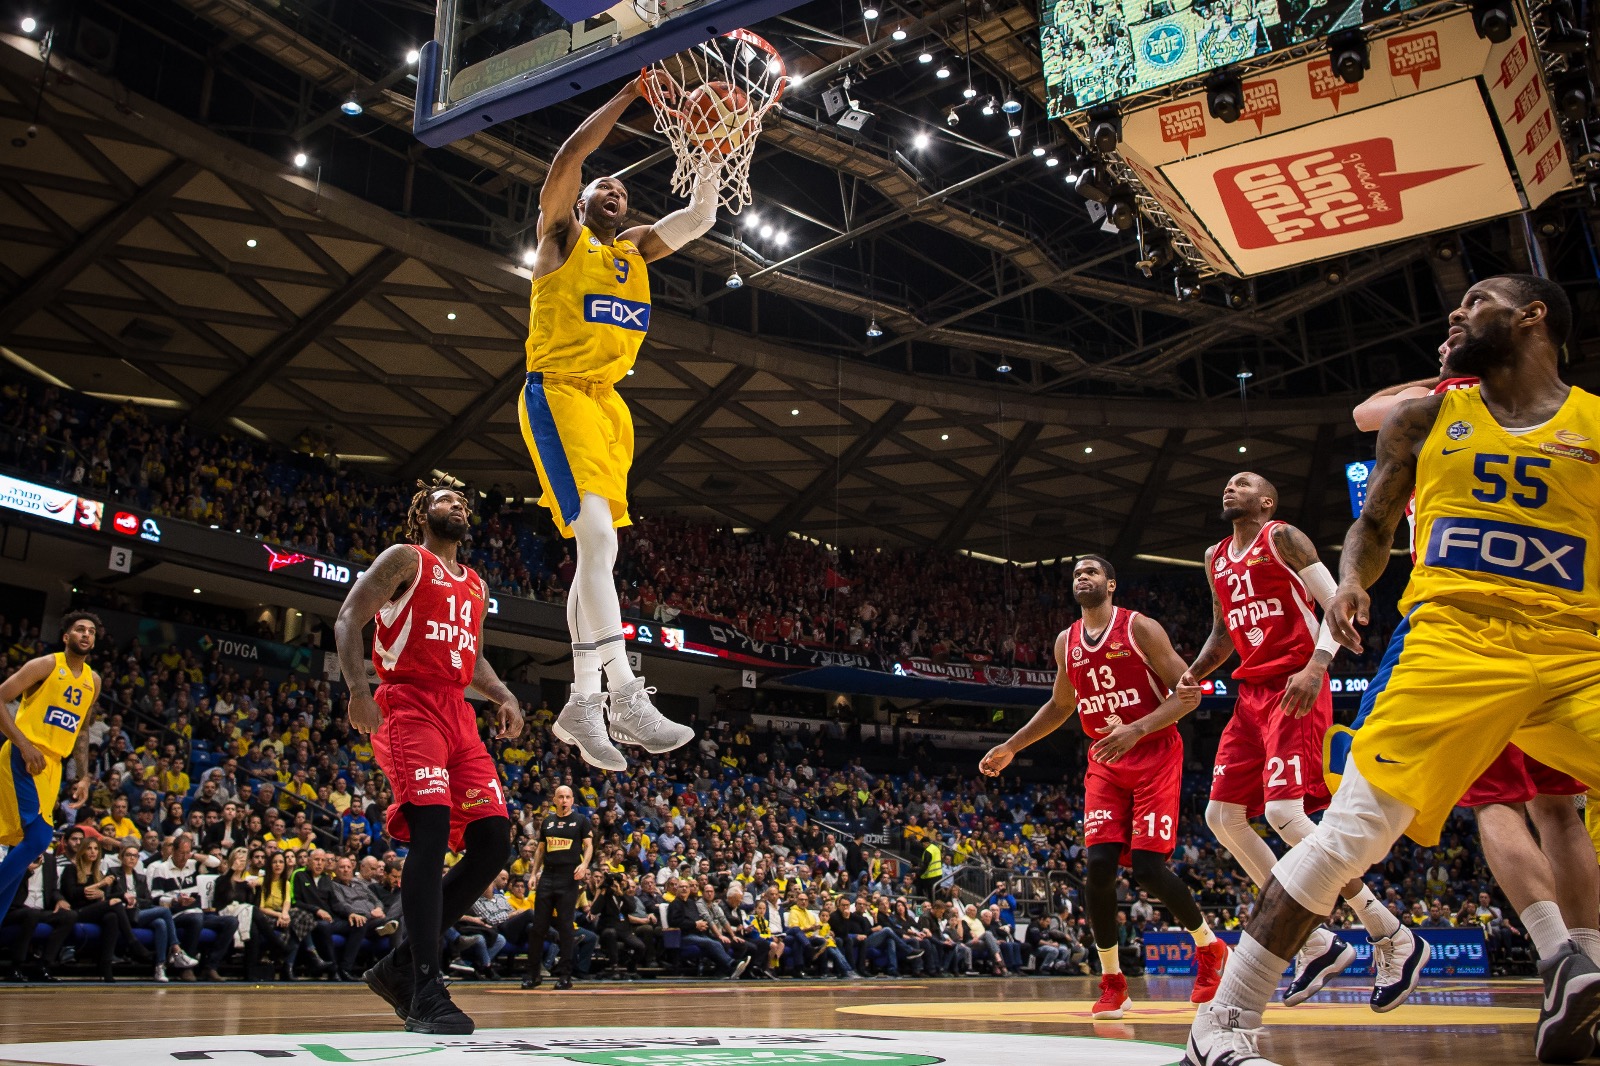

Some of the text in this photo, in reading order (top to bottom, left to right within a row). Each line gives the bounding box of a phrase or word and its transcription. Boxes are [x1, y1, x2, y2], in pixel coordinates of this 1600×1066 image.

[1233, 163, 1316, 243] מעדני
[1287, 151, 1370, 230] הטלה
[613, 257, 629, 284] 9
[591, 300, 646, 327] FOX
[1472, 453, 1552, 509] 55
[0, 492, 40, 511] מבטחי
[79, 500, 97, 525] 3
[115, 552, 126, 567] 3
[1439, 526, 1574, 581] FOX
[313, 560, 350, 584] מגה
[1227, 570, 1255, 603] 21
[446, 594, 472, 628] 14
[217, 638, 259, 660] TOYGA
[663, 628, 677, 649] 3
[745, 674, 754, 687] 4
[1086, 665, 1116, 692] 13
[63, 685, 82, 706] 43
[48, 709, 81, 731] FOX
[1267, 755, 1303, 788] 21
[488, 778, 506, 805] 1
[1143, 812, 1173, 841] 13
